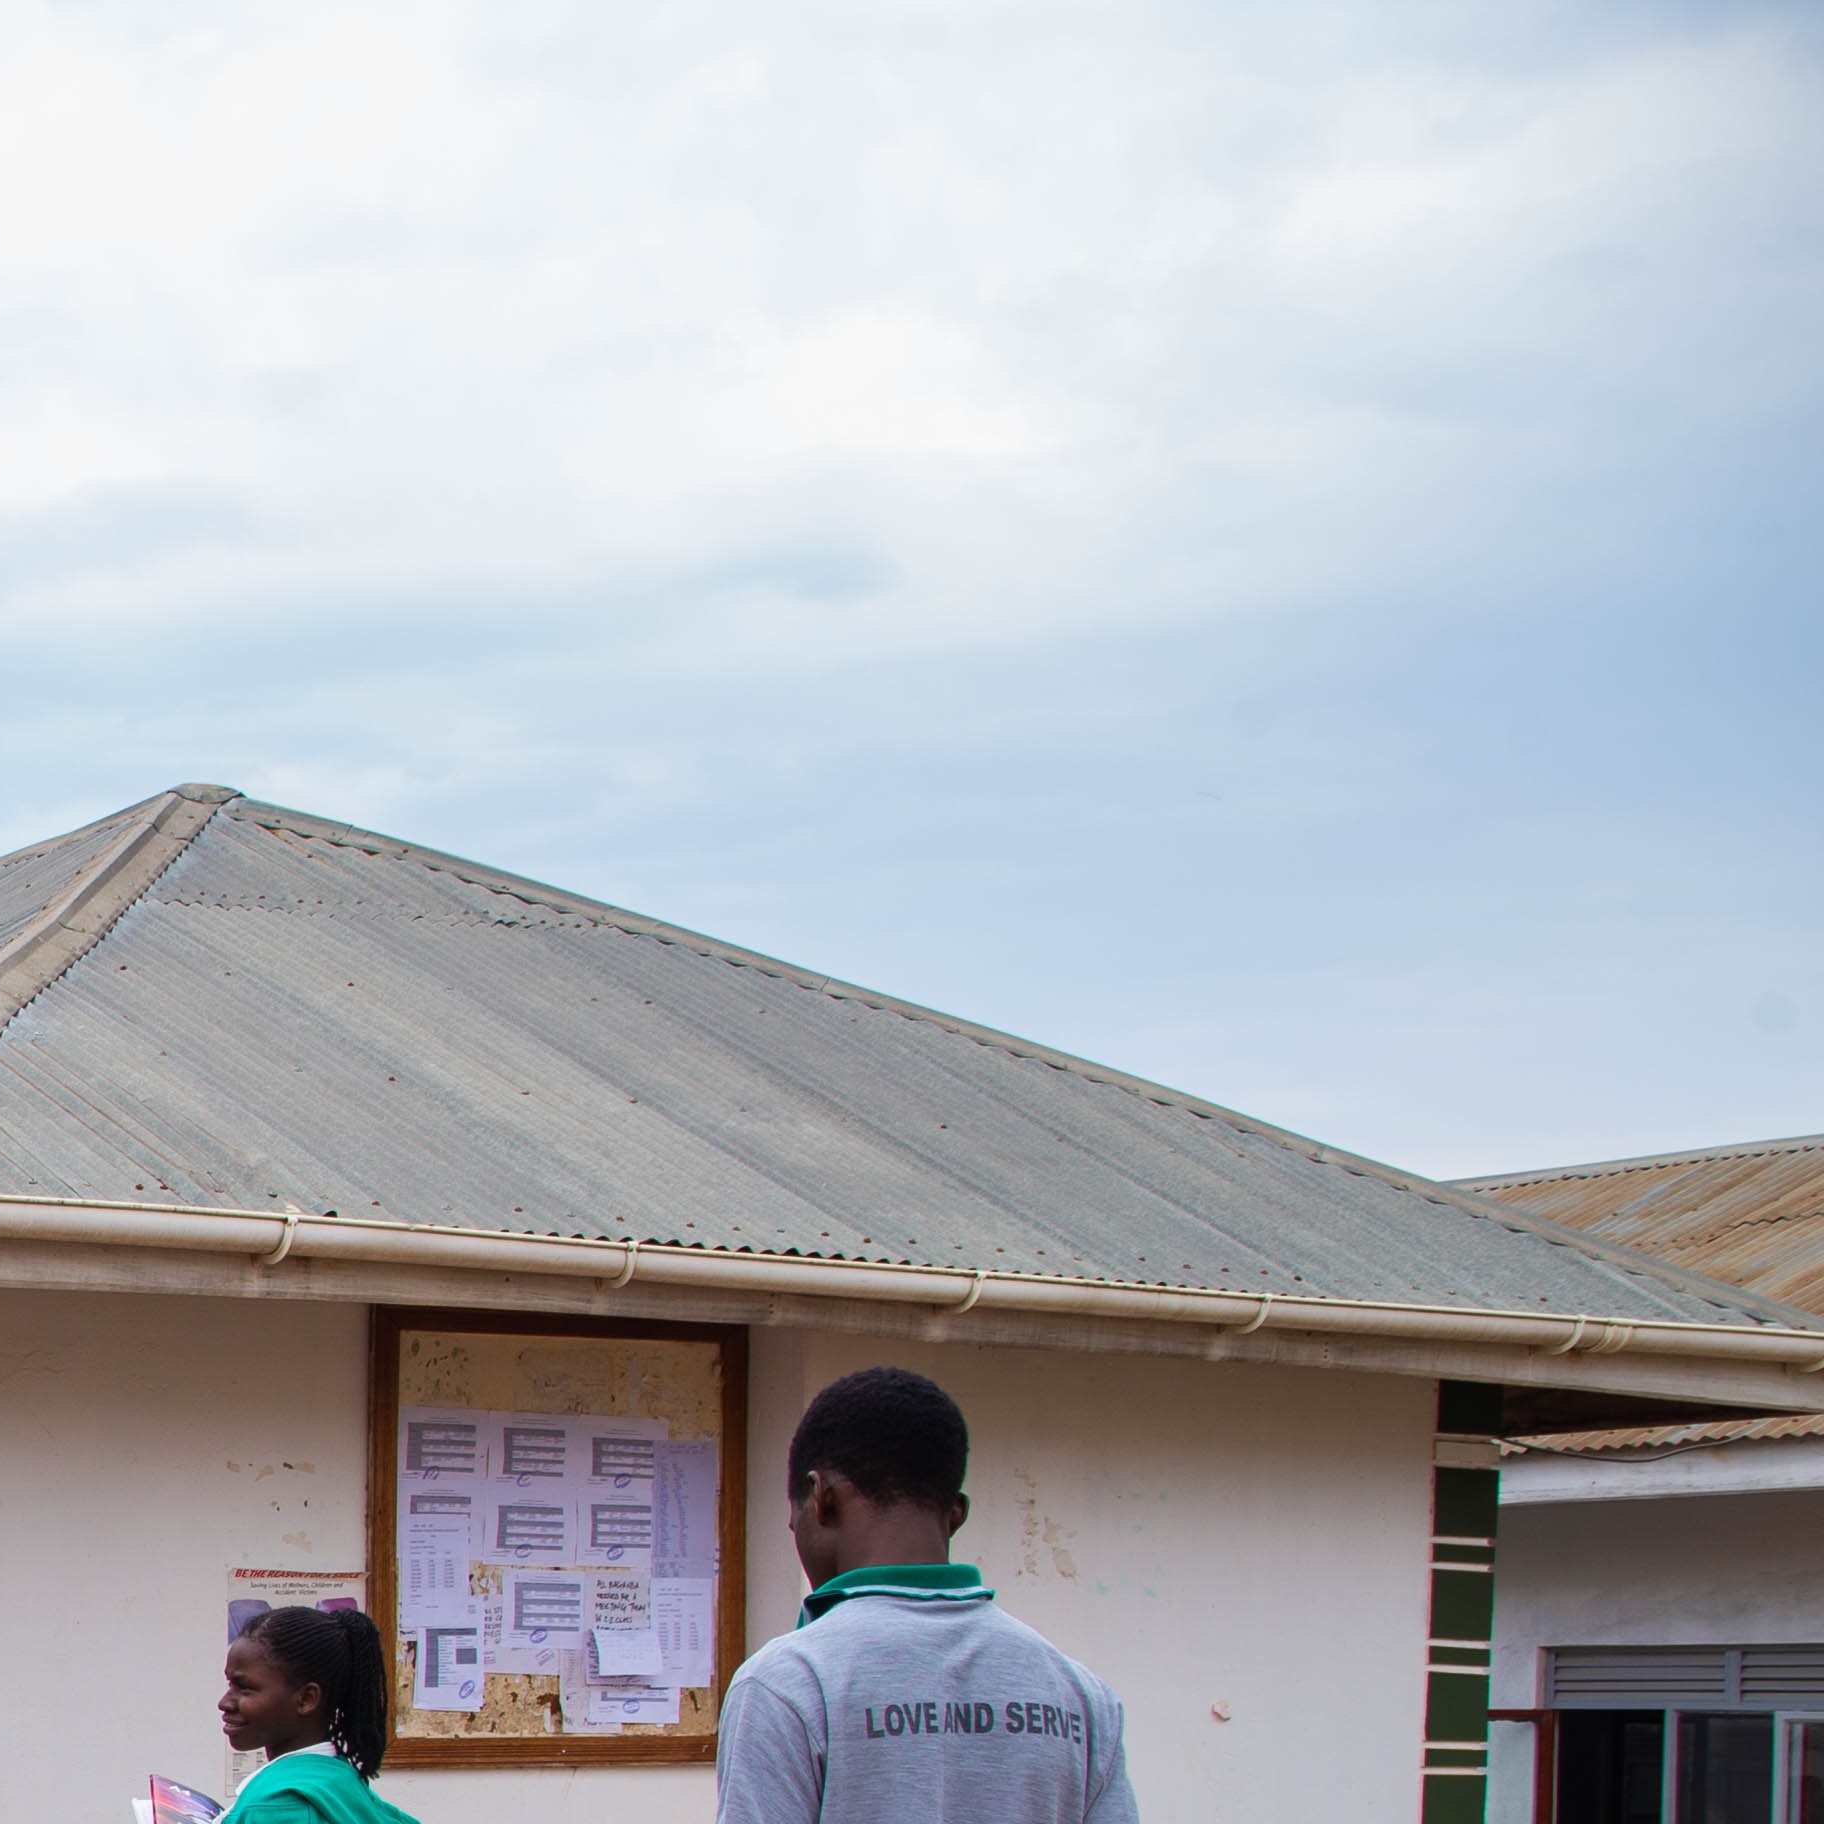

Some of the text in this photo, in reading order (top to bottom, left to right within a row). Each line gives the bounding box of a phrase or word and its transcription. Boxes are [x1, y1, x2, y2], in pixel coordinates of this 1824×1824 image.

[235, 1569, 248, 1578] BE
[249, 1569, 266, 1578] THE
[267, 1570, 303, 1578] REASON
[864, 1702, 1082, 1745] LOVE AND SERVE
